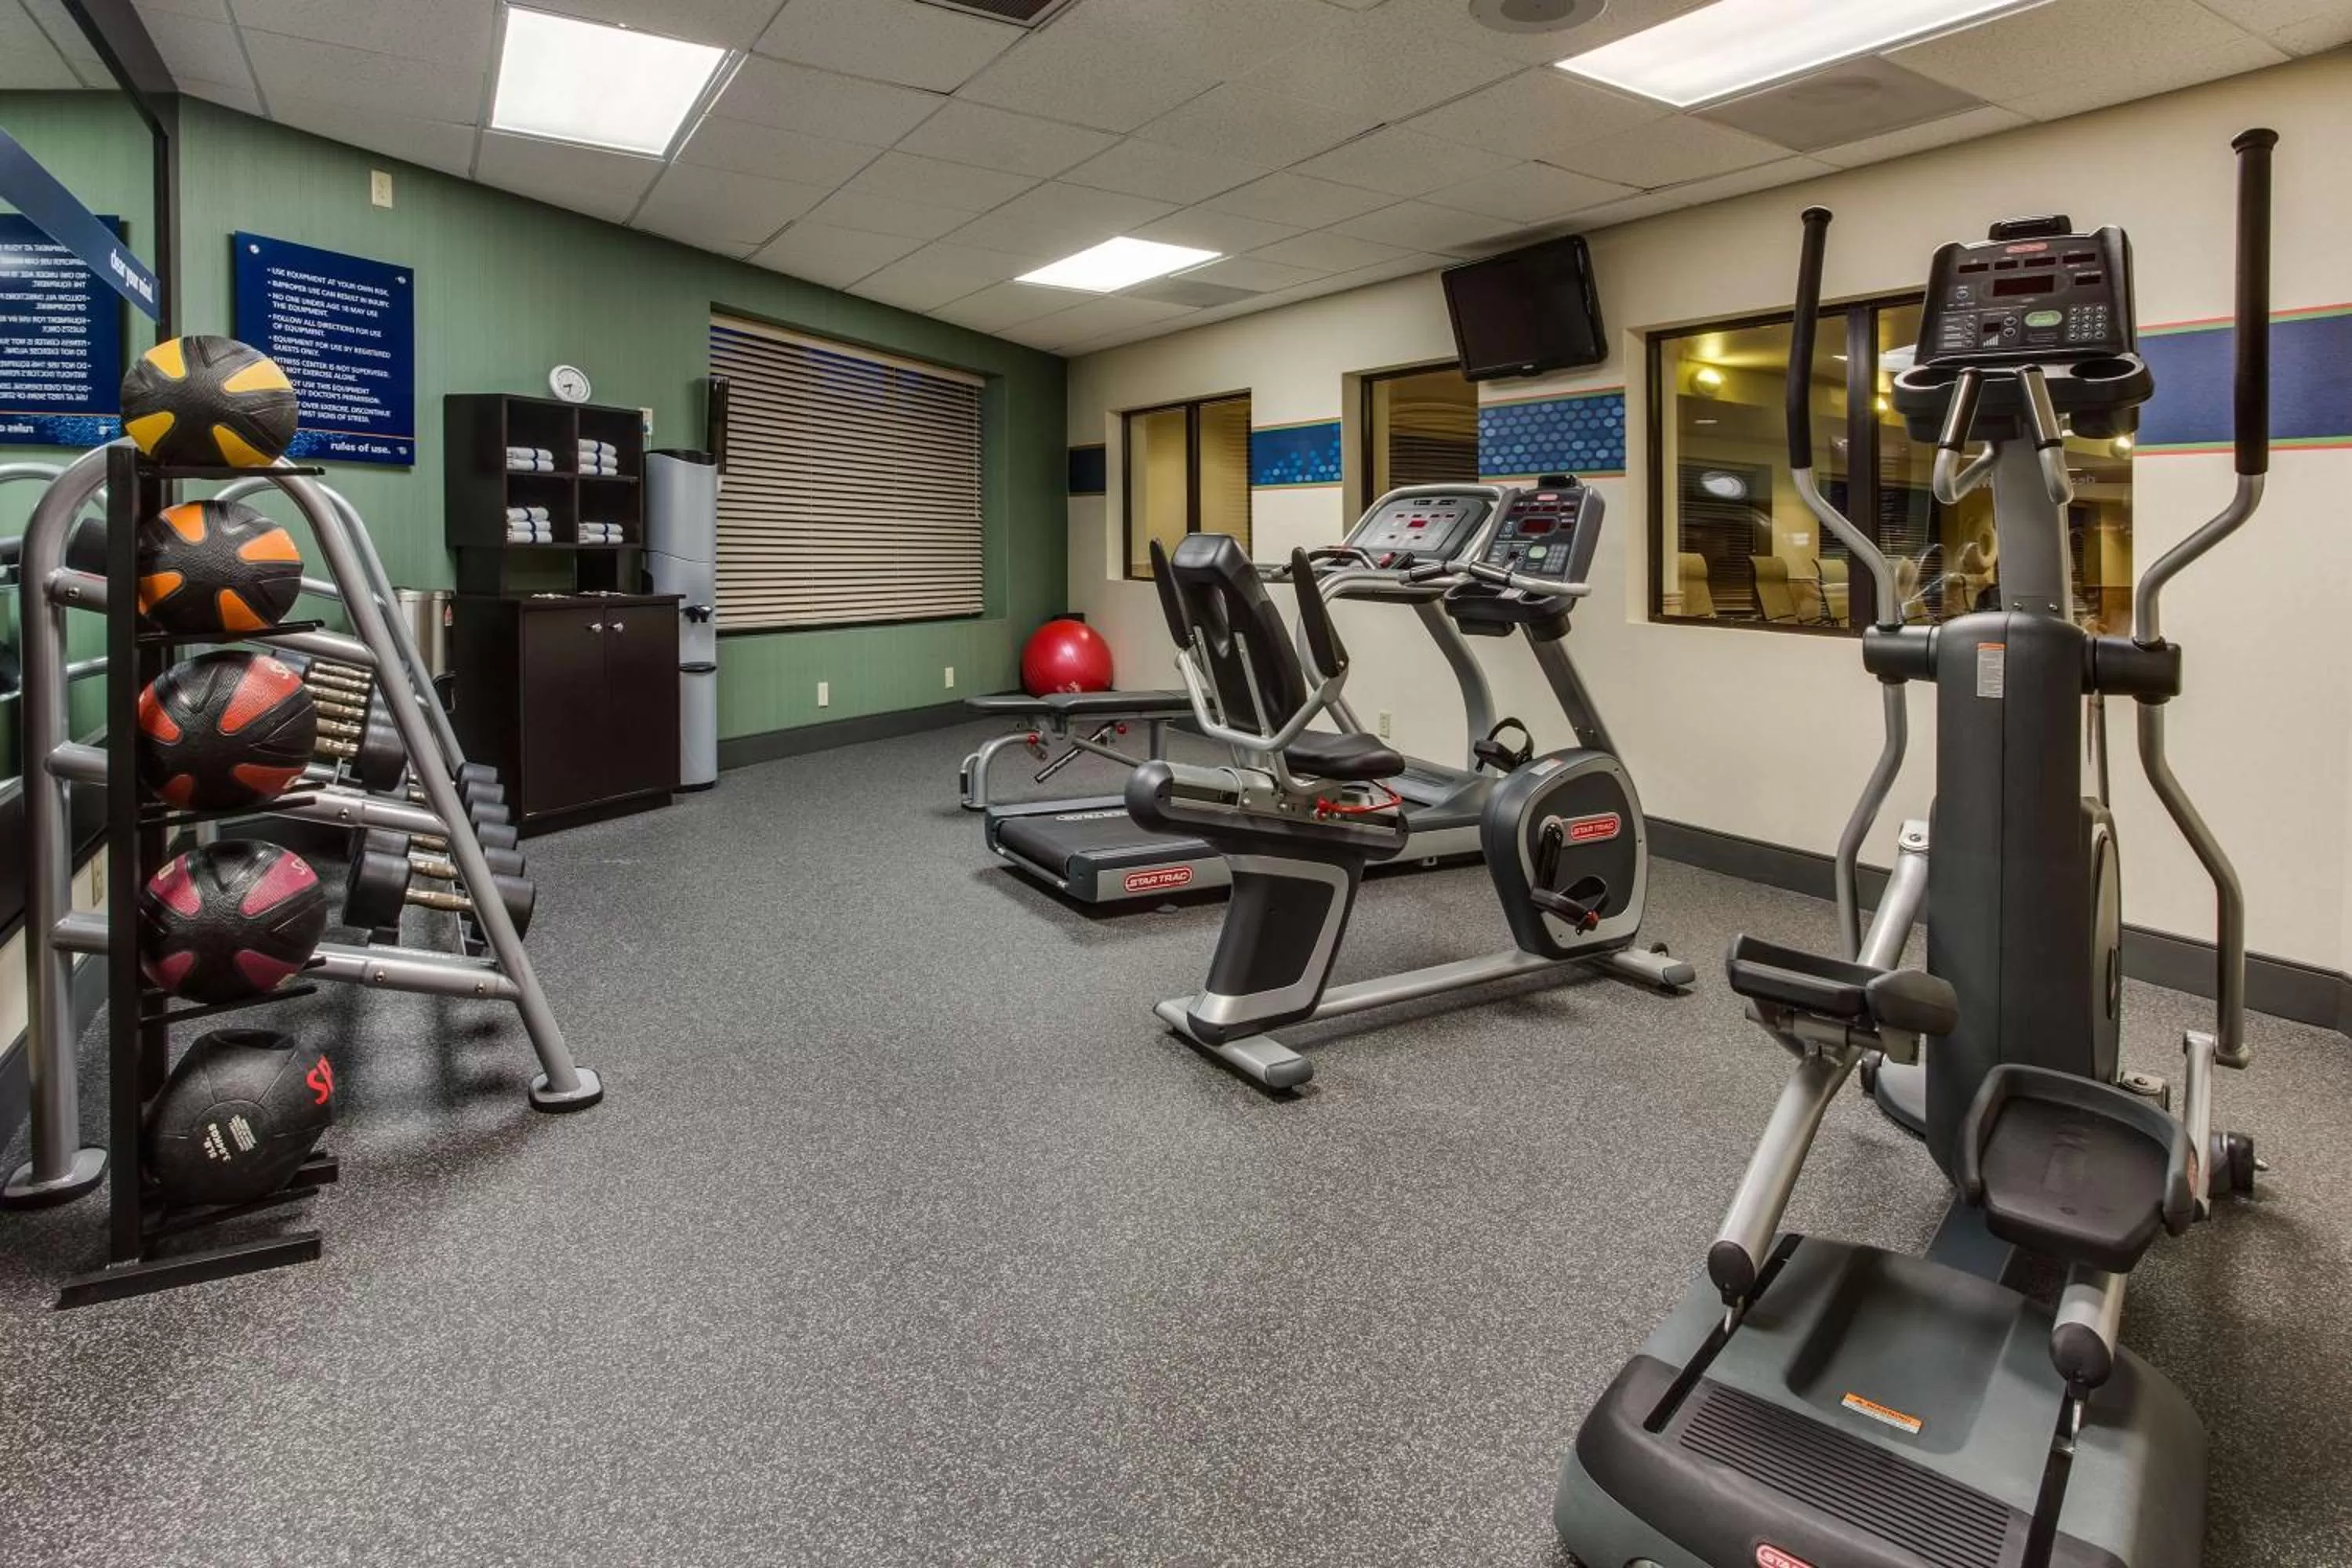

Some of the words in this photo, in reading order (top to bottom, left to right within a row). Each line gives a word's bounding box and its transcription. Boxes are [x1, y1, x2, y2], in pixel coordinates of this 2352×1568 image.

[272, 267, 285, 277] USE
[286, 270, 325, 284] EQUIPMENT
[337, 279, 355, 290] YOUR
[357, 283, 372, 293] OWN
[272, 280, 306, 293] IMPROPER
[307, 286, 320, 296] USE
[321, 289, 336, 298] CAN
[336, 292, 358, 303] RESULT
[272, 301, 285, 310] THE
[285, 295, 299, 304] ONE
[301, 298, 325, 308] UNDER
[325, 302, 339, 310] AGE
[350, 306, 365, 315] MAY
[365, 308, 378, 317] USE
[272, 313, 302, 325] FOLLOW
[303, 318, 315, 327] ALL
[316, 320, 354, 333] DIRECTIONS
[355, 326, 368, 335] FOR
[369, 328, 382, 337] USE
[273, 335, 314, 347] EQUIPMENT
[314, 341, 328, 350] FOR
[330, 343, 342, 351] USE
[354, 346, 390, 358] REGISTERED
[273, 343, 299, 354] GUESTS
[286, 366, 300, 375] NOT
[302, 368, 332, 379] EXERCISE
[301, 359, 328, 370] CENTER
[335, 364, 350, 373] NOT
[302, 380, 315, 389] USE
[316, 382, 330, 390] THIS
[332, 383, 369, 394] EQUIPMENT
[307, 390, 340, 401] DOCTOR'S
[299, 409, 316, 418] FIRST
[317, 412, 336, 420] SIGNS
[300, 401, 318, 410] OVER
[350, 406, 390, 417] DISCONTINUE
[330, 441, 355, 452] rules
[370, 445, 390, 455] use.
[1574, 826, 1593, 835] STAR
[1595, 822, 1614, 832] TRAC
[1129, 876, 1157, 887] STAR
[1158, 871, 1189, 883] TRAC
